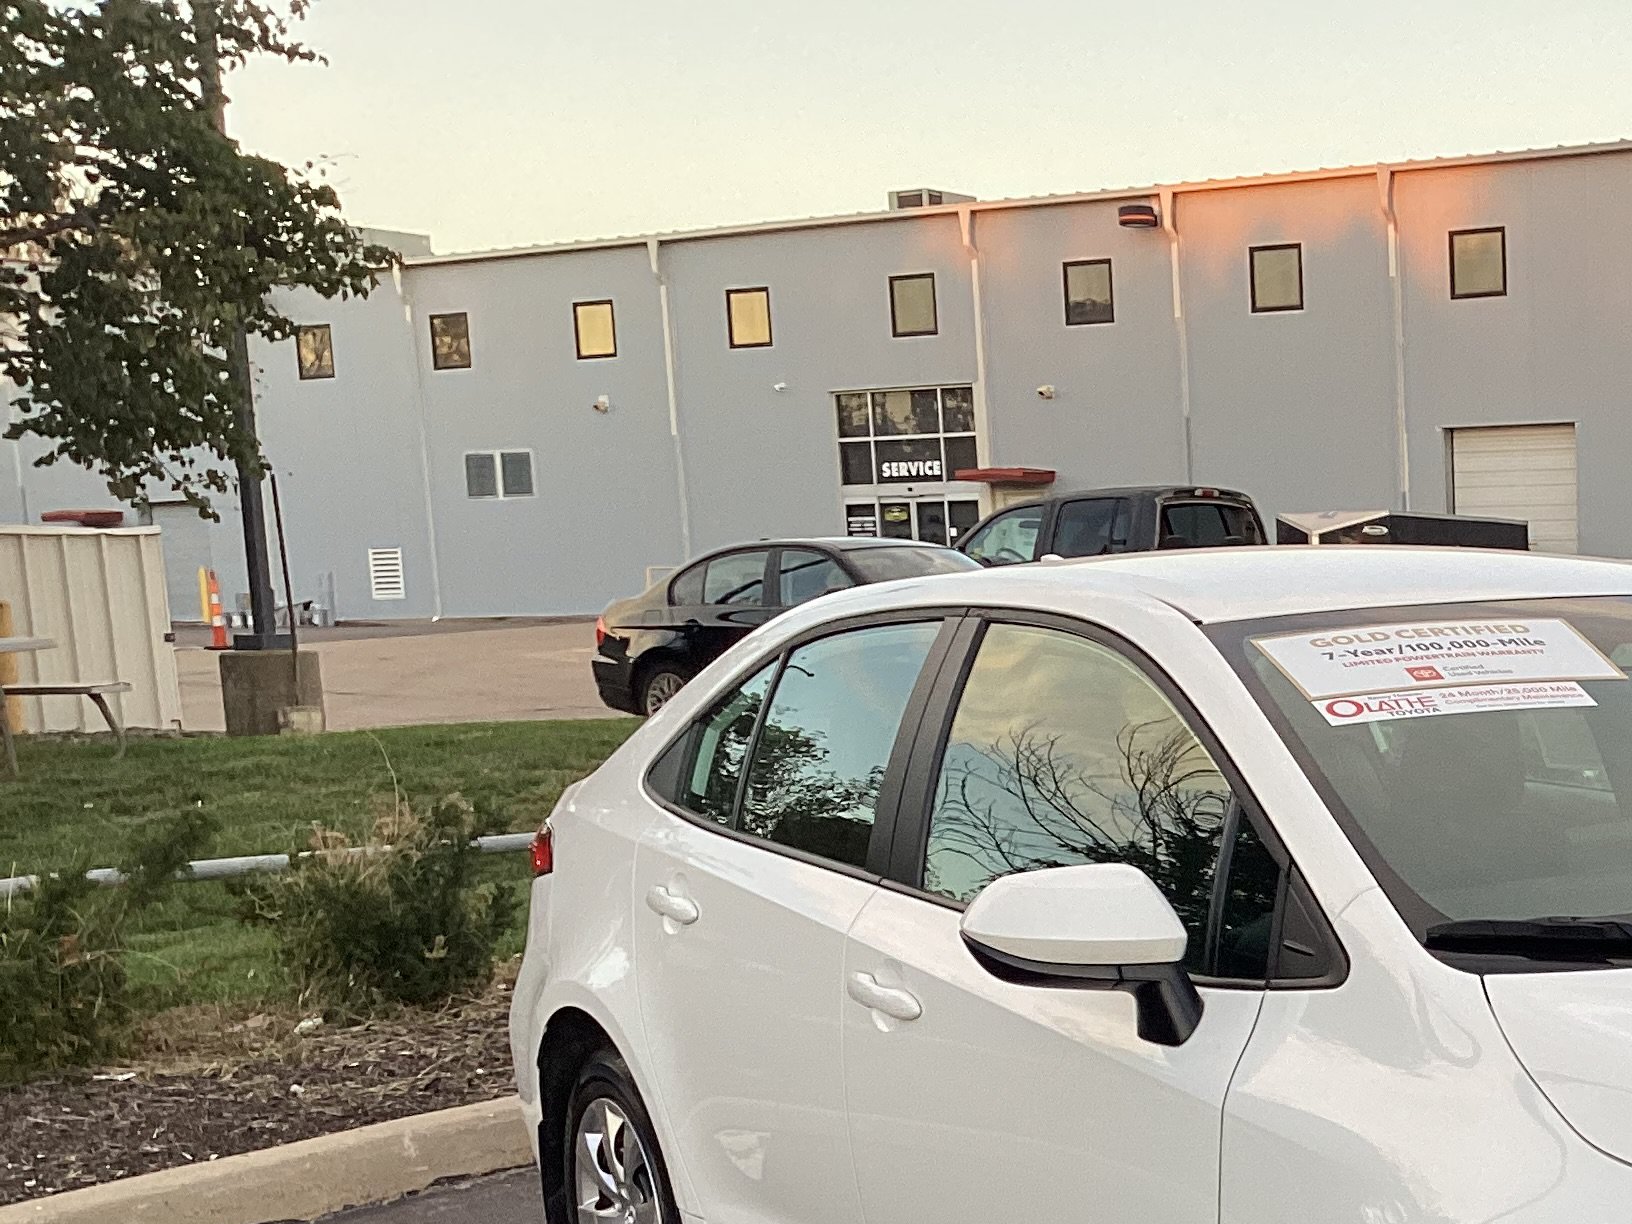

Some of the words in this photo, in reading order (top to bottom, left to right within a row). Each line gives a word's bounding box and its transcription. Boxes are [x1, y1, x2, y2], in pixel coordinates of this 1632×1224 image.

[882, 460, 941, 477] SERVICE
[1309, 631, 1391, 648] GOLD
[1394, 625, 1530, 638] CERTIFIED
[1342, 658, 1393, 668] LIMITED
[1394, 650, 1477, 664] POWERTRAIN
[1477, 648, 1545, 658] WARRANTY
[1443, 664, 1485, 672] Certified
[1550, 685, 1577, 693] Mile
[1325, 695, 1438, 718] OLATHE
[1387, 707, 1442, 717] TOYOTA
